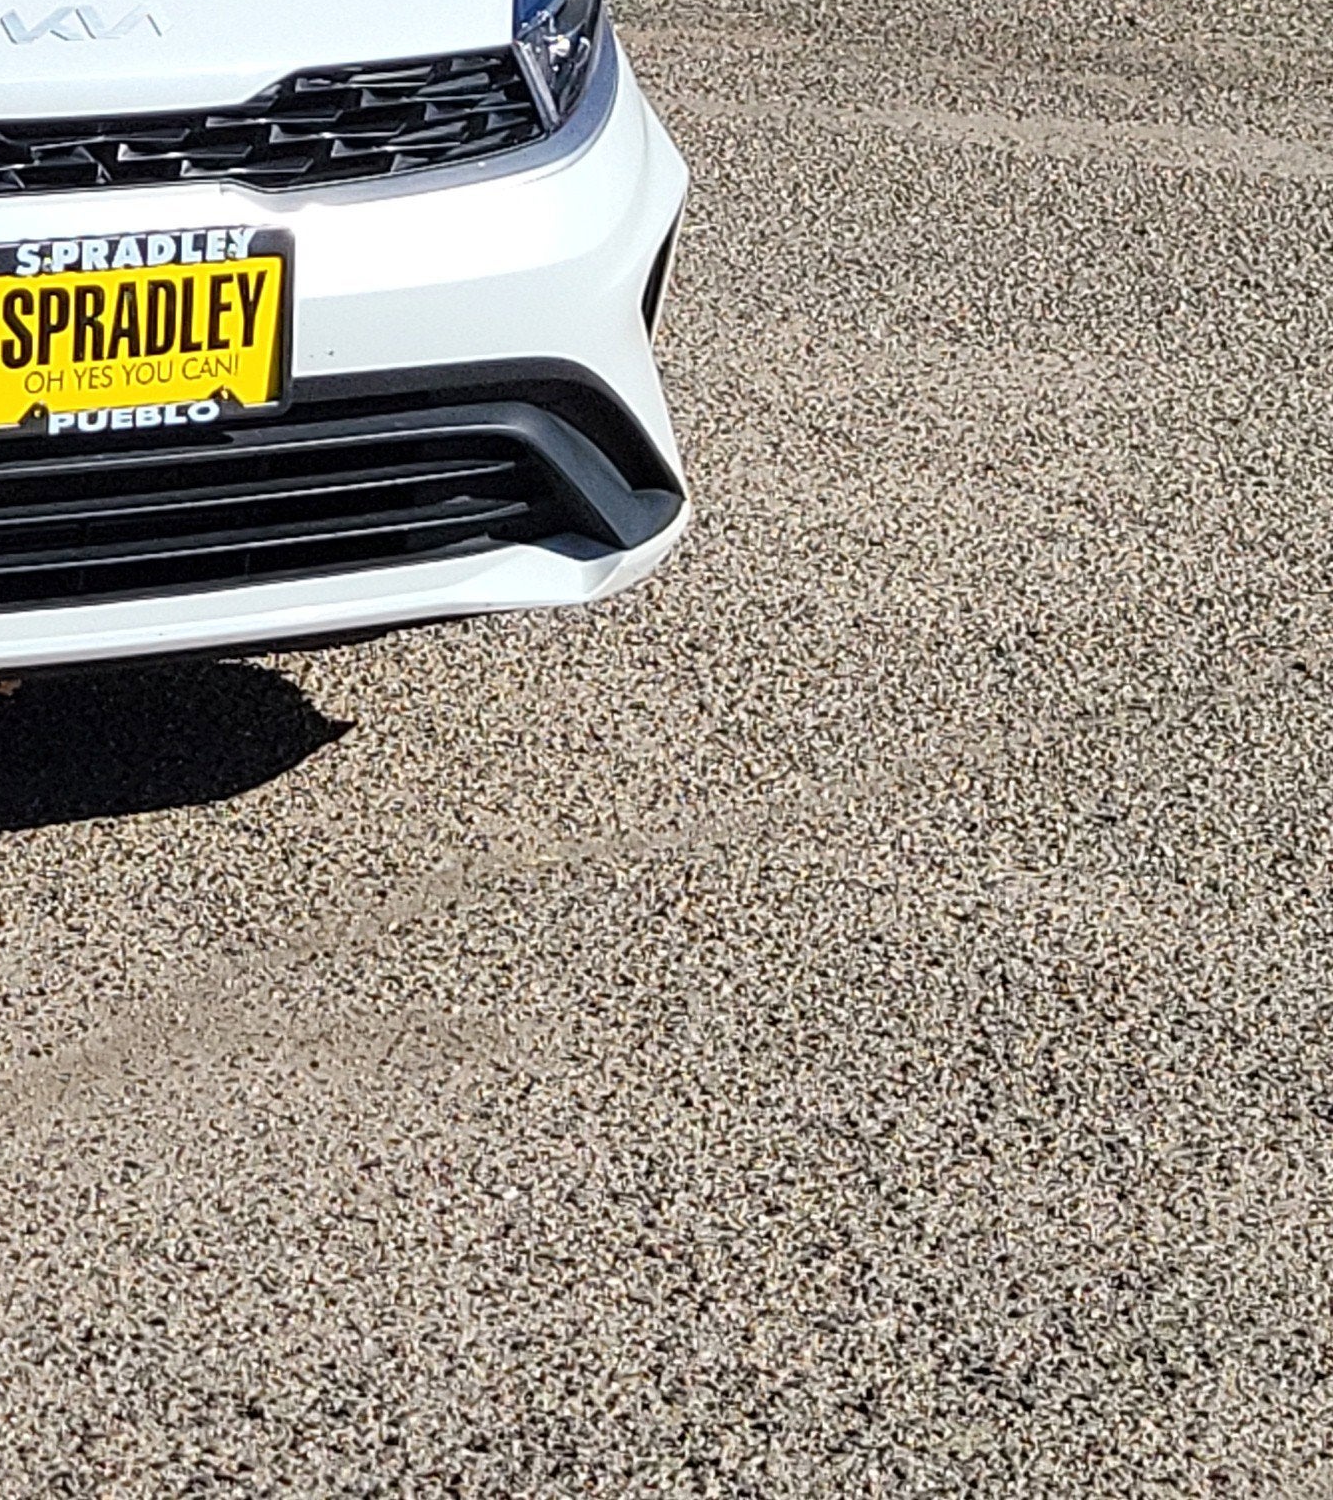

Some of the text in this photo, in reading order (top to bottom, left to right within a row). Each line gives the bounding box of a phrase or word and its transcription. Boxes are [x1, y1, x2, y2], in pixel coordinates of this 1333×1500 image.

[15, 227, 257, 276] SPRADLEY
[0, 269, 268, 370] SPRADLEY
[24, 353, 239, 394] OH YES YOU CAN!
[47, 399, 221, 436] PUEBLO
